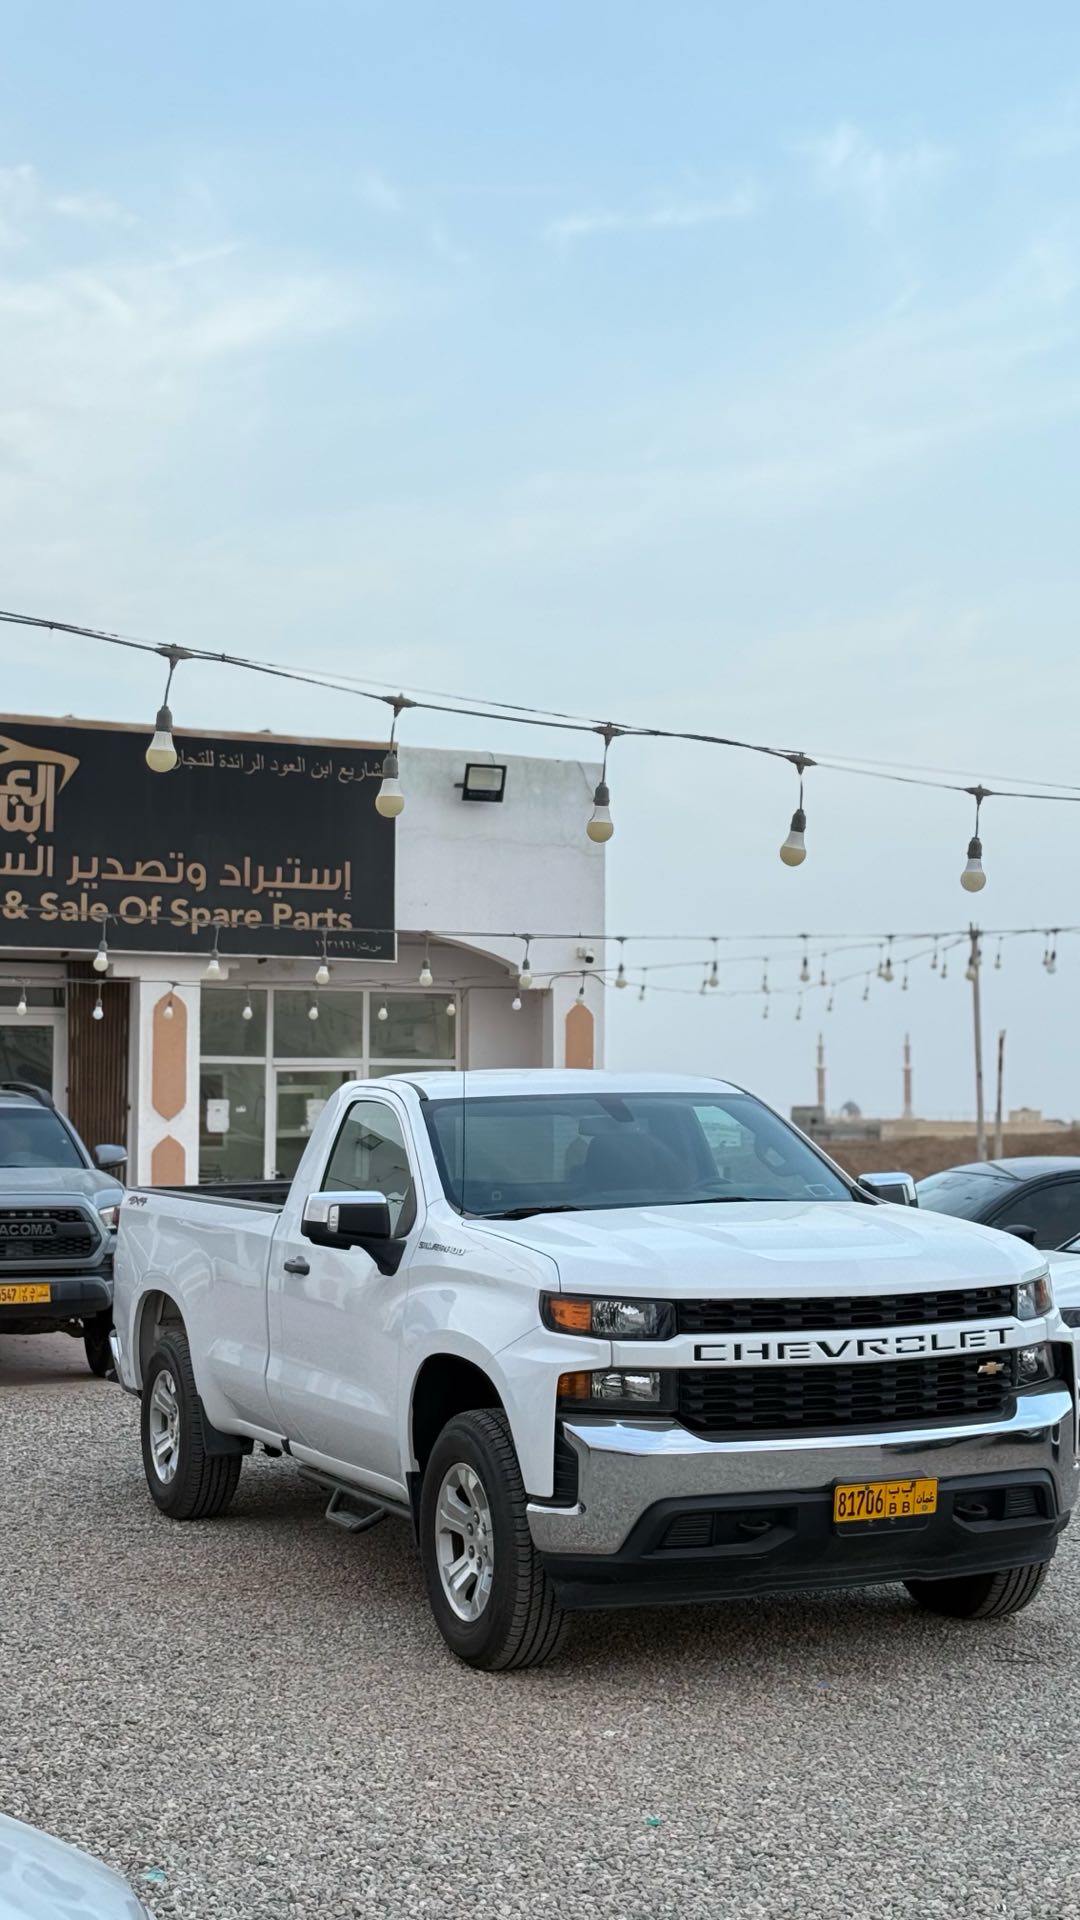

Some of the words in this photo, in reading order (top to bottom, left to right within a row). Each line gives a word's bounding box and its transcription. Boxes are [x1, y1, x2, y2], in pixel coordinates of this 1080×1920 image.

[173, 749, 214, 769] للتجار
[270, 756, 305, 776] العود
[311, 759, 332, 779] ابن
[338, 759, 388, 783] شاريع
[66, 852, 207, 890] وتصدير
[219, 856, 352, 900] إستيراد
[2, 890, 29, 919] &
[39, 892, 108, 922] Sale
[119, 895, 162, 926] Of
[170, 899, 262, 934] Spare
[273, 903, 353, 930] Parts
[0, 1223, 54, 1236] ACOMA
[694, 1326, 1016, 1362] CHEVROLET
[837, 1488, 884, 1517] 81706
